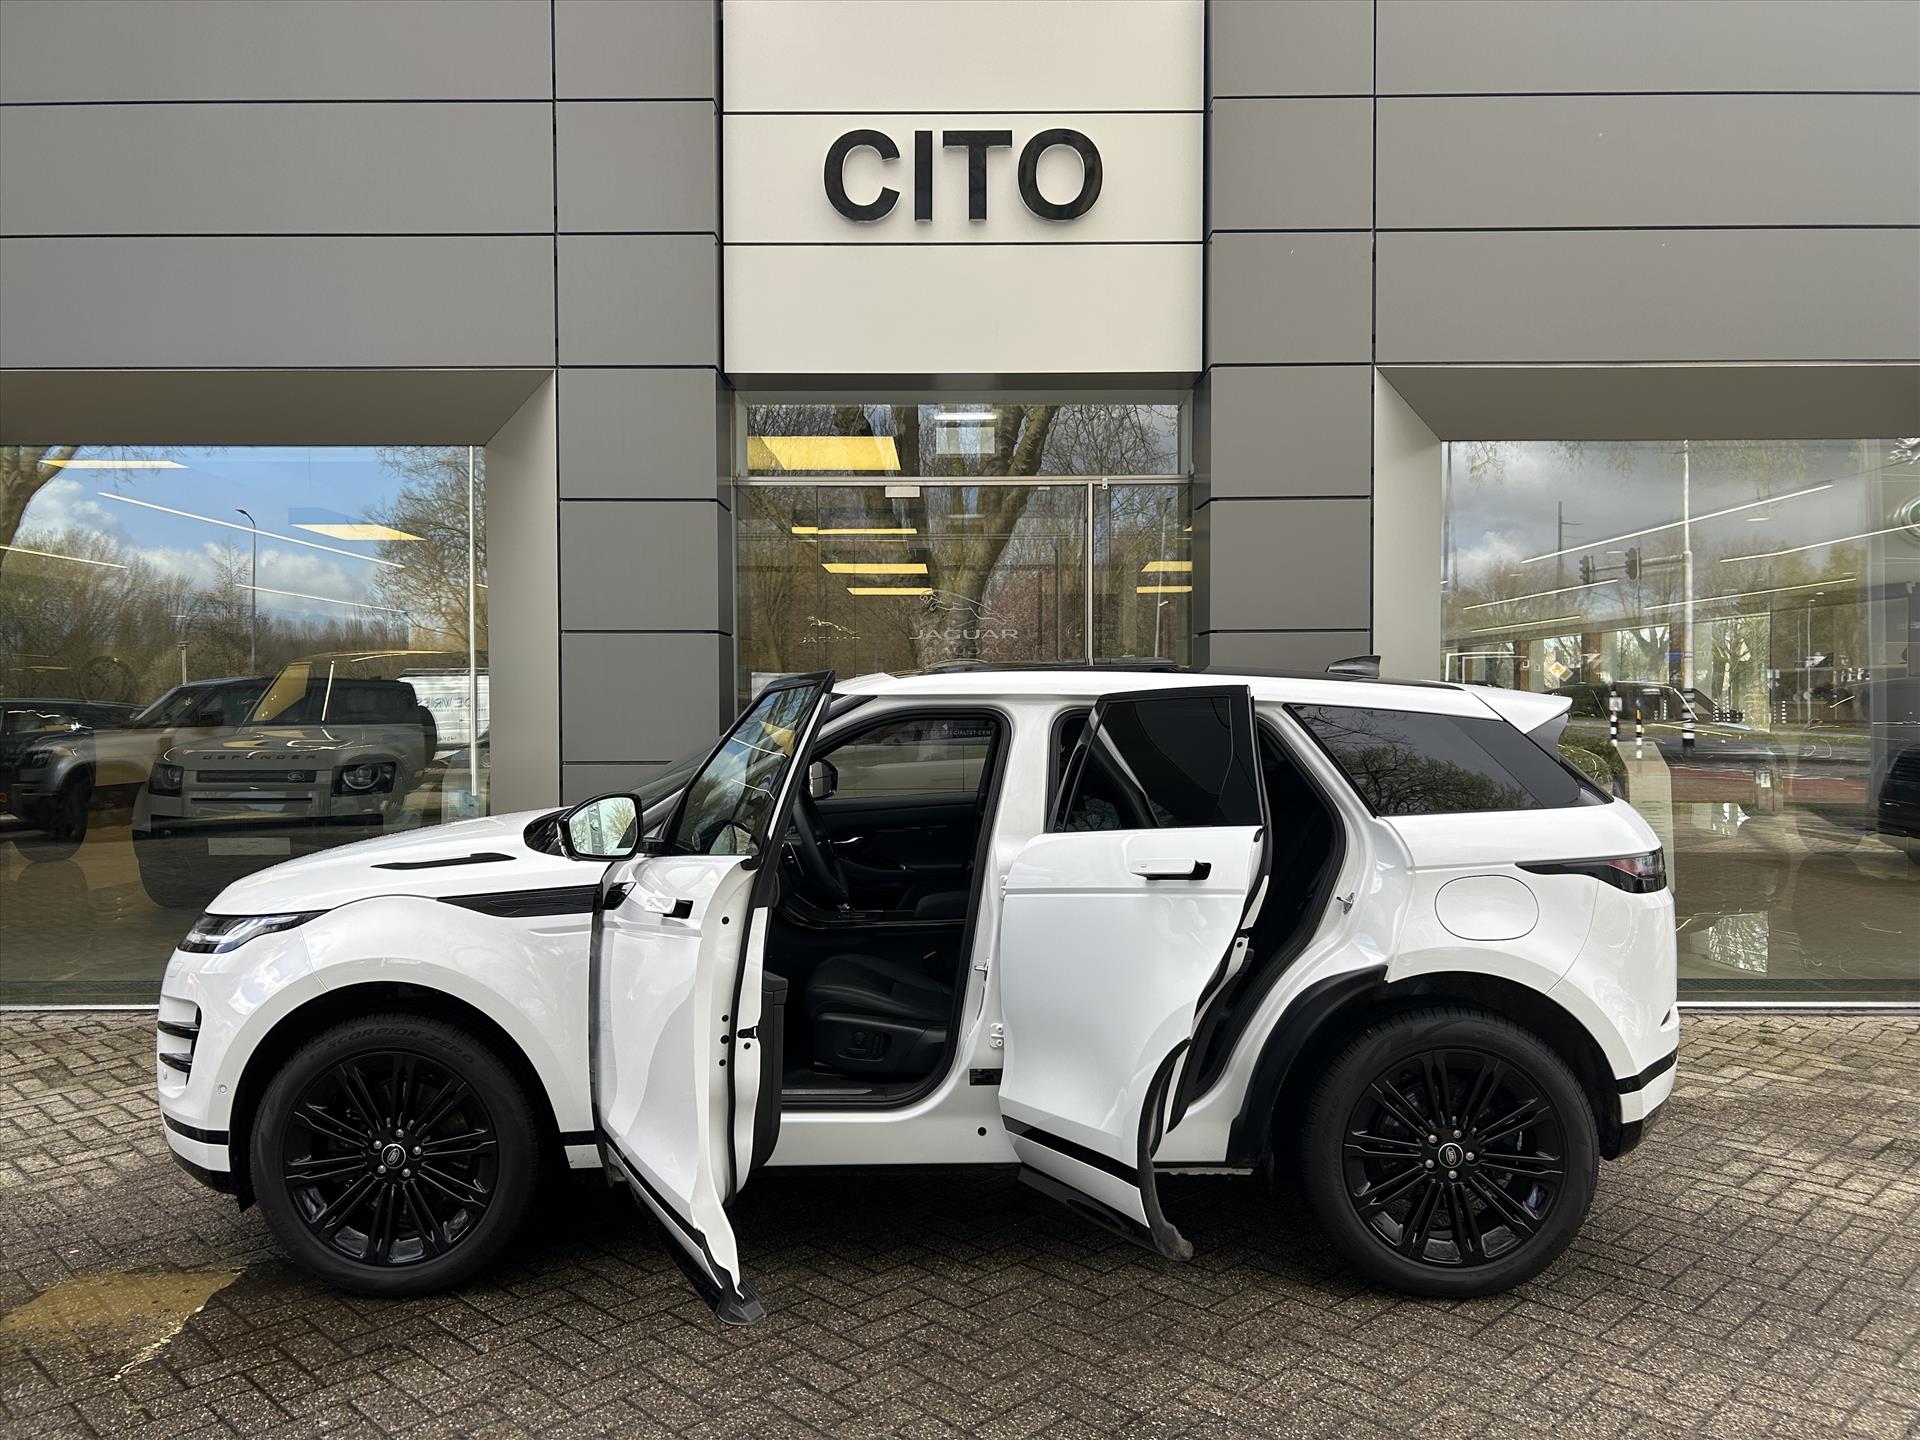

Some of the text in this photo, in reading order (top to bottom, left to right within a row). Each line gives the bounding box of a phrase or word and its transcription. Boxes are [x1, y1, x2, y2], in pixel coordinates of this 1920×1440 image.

[823, 128, 1103, 222] CITO
[909, 629, 1019, 640] JAGUAR
[327, 1028, 474, 1064] SCORPION ZERO
